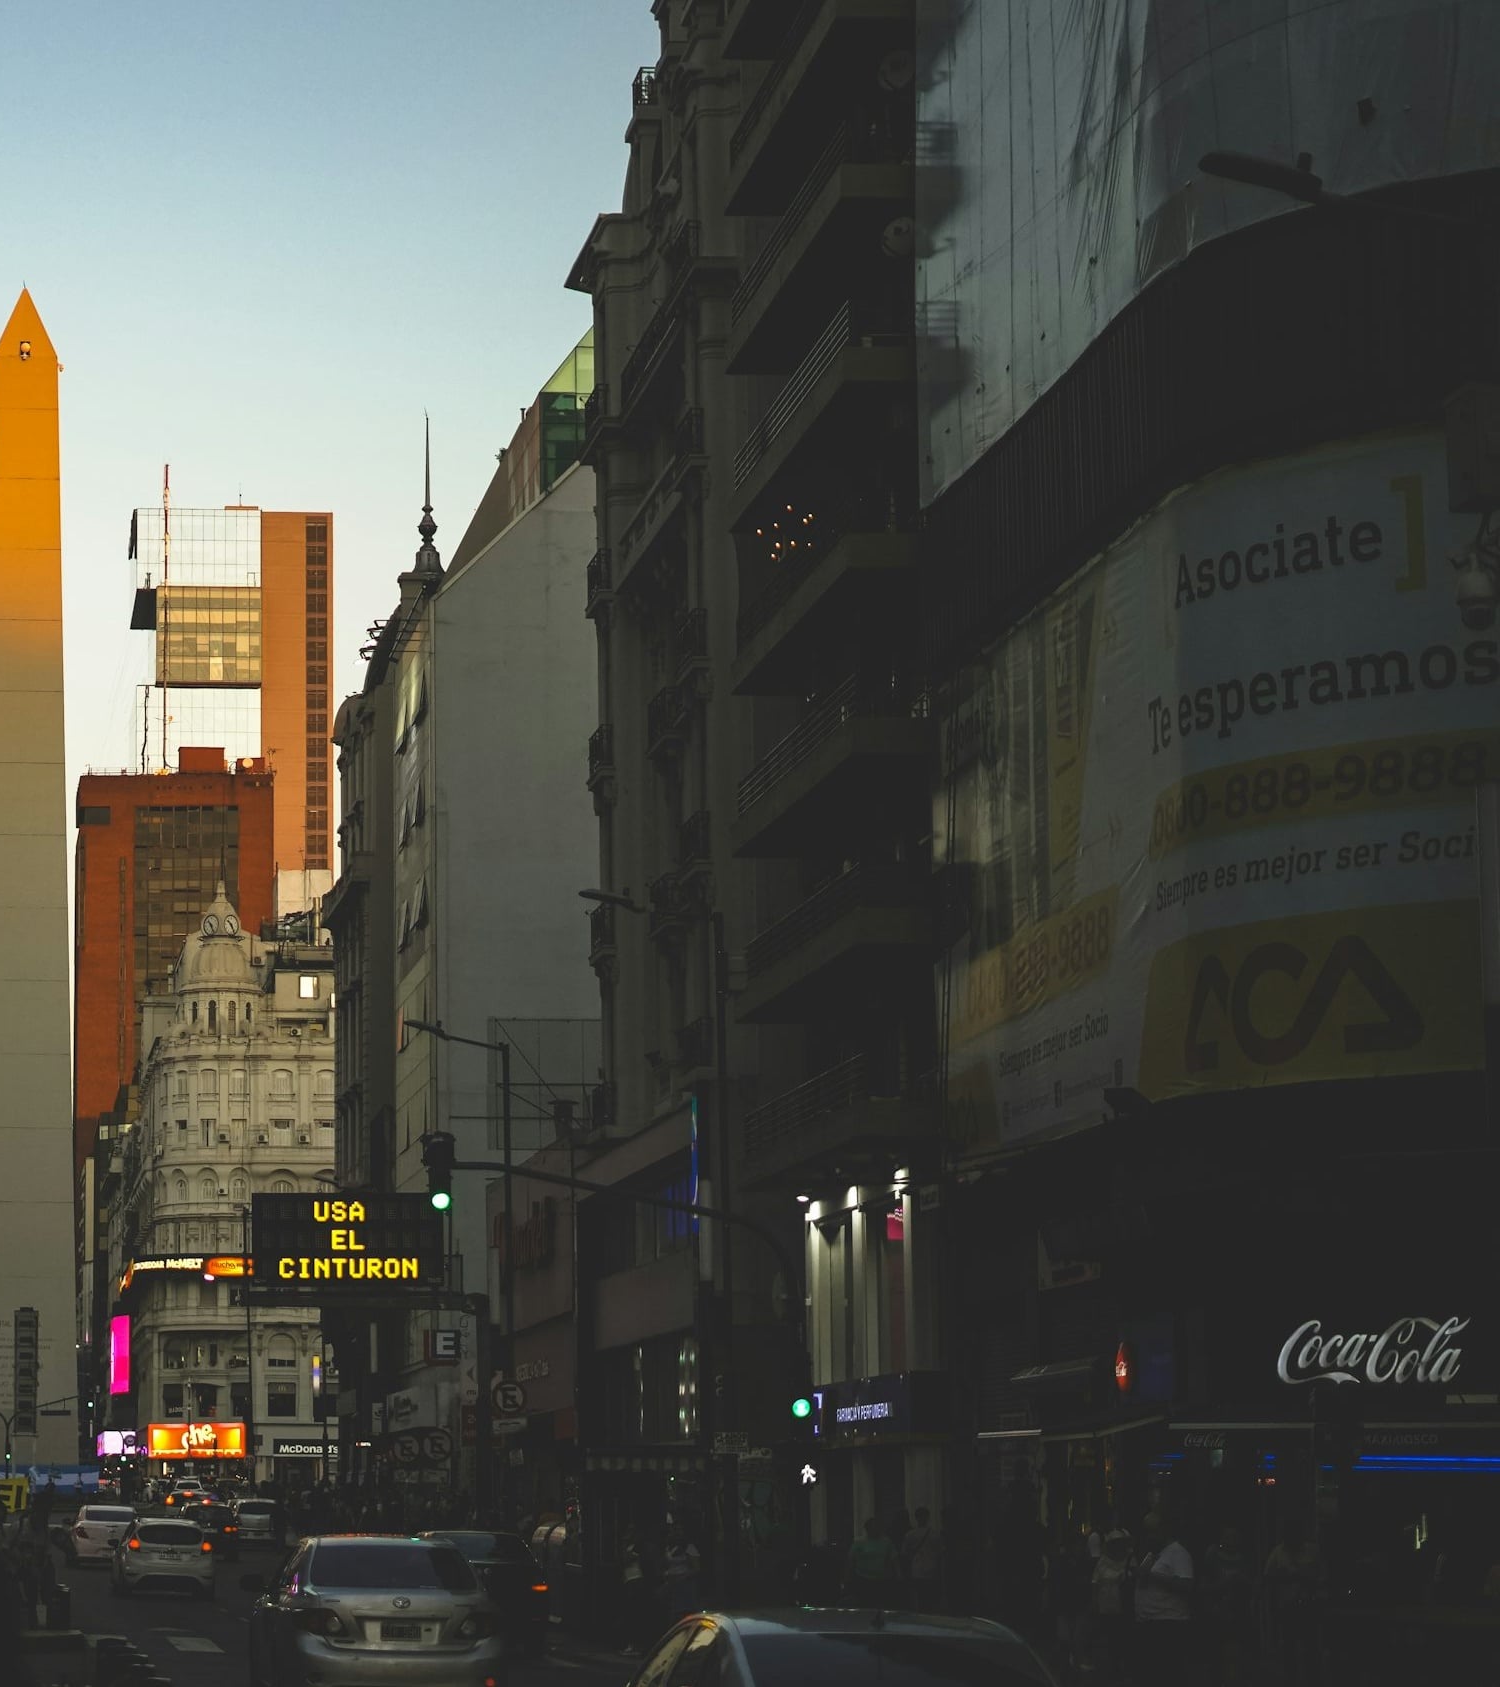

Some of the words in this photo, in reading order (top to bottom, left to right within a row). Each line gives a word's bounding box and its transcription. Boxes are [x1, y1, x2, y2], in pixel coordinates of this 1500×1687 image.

[1175, 516, 1383, 609] Asociate
[1148, 696, 1172, 755] Te
[1177, 640, 1500, 739] esperamos
[1153, 742, 1488, 849] 0800-888-9888
[1156, 869, 1209, 912] Siempre
[1214, 863, 1237, 888] es
[1244, 846, 1327, 884] mejor
[1336, 842, 1388, 870] ser
[1185, 935, 1425, 1072] ACA
[999, 1050, 1031, 1078] Siempre
[1042, 1027, 1068, 1062] mejor
[1084, 1008, 1109, 1040] Socio
[313, 1201, 365, 1222] USA
[331, 1229, 366, 1251] EL
[278, 1258, 419, 1279] CINTURON
[436, 1331, 456, 1355] E
[1277, 1317, 1471, 1385] Coca-Cola
[279, 1444, 338, 1454] McDona's
